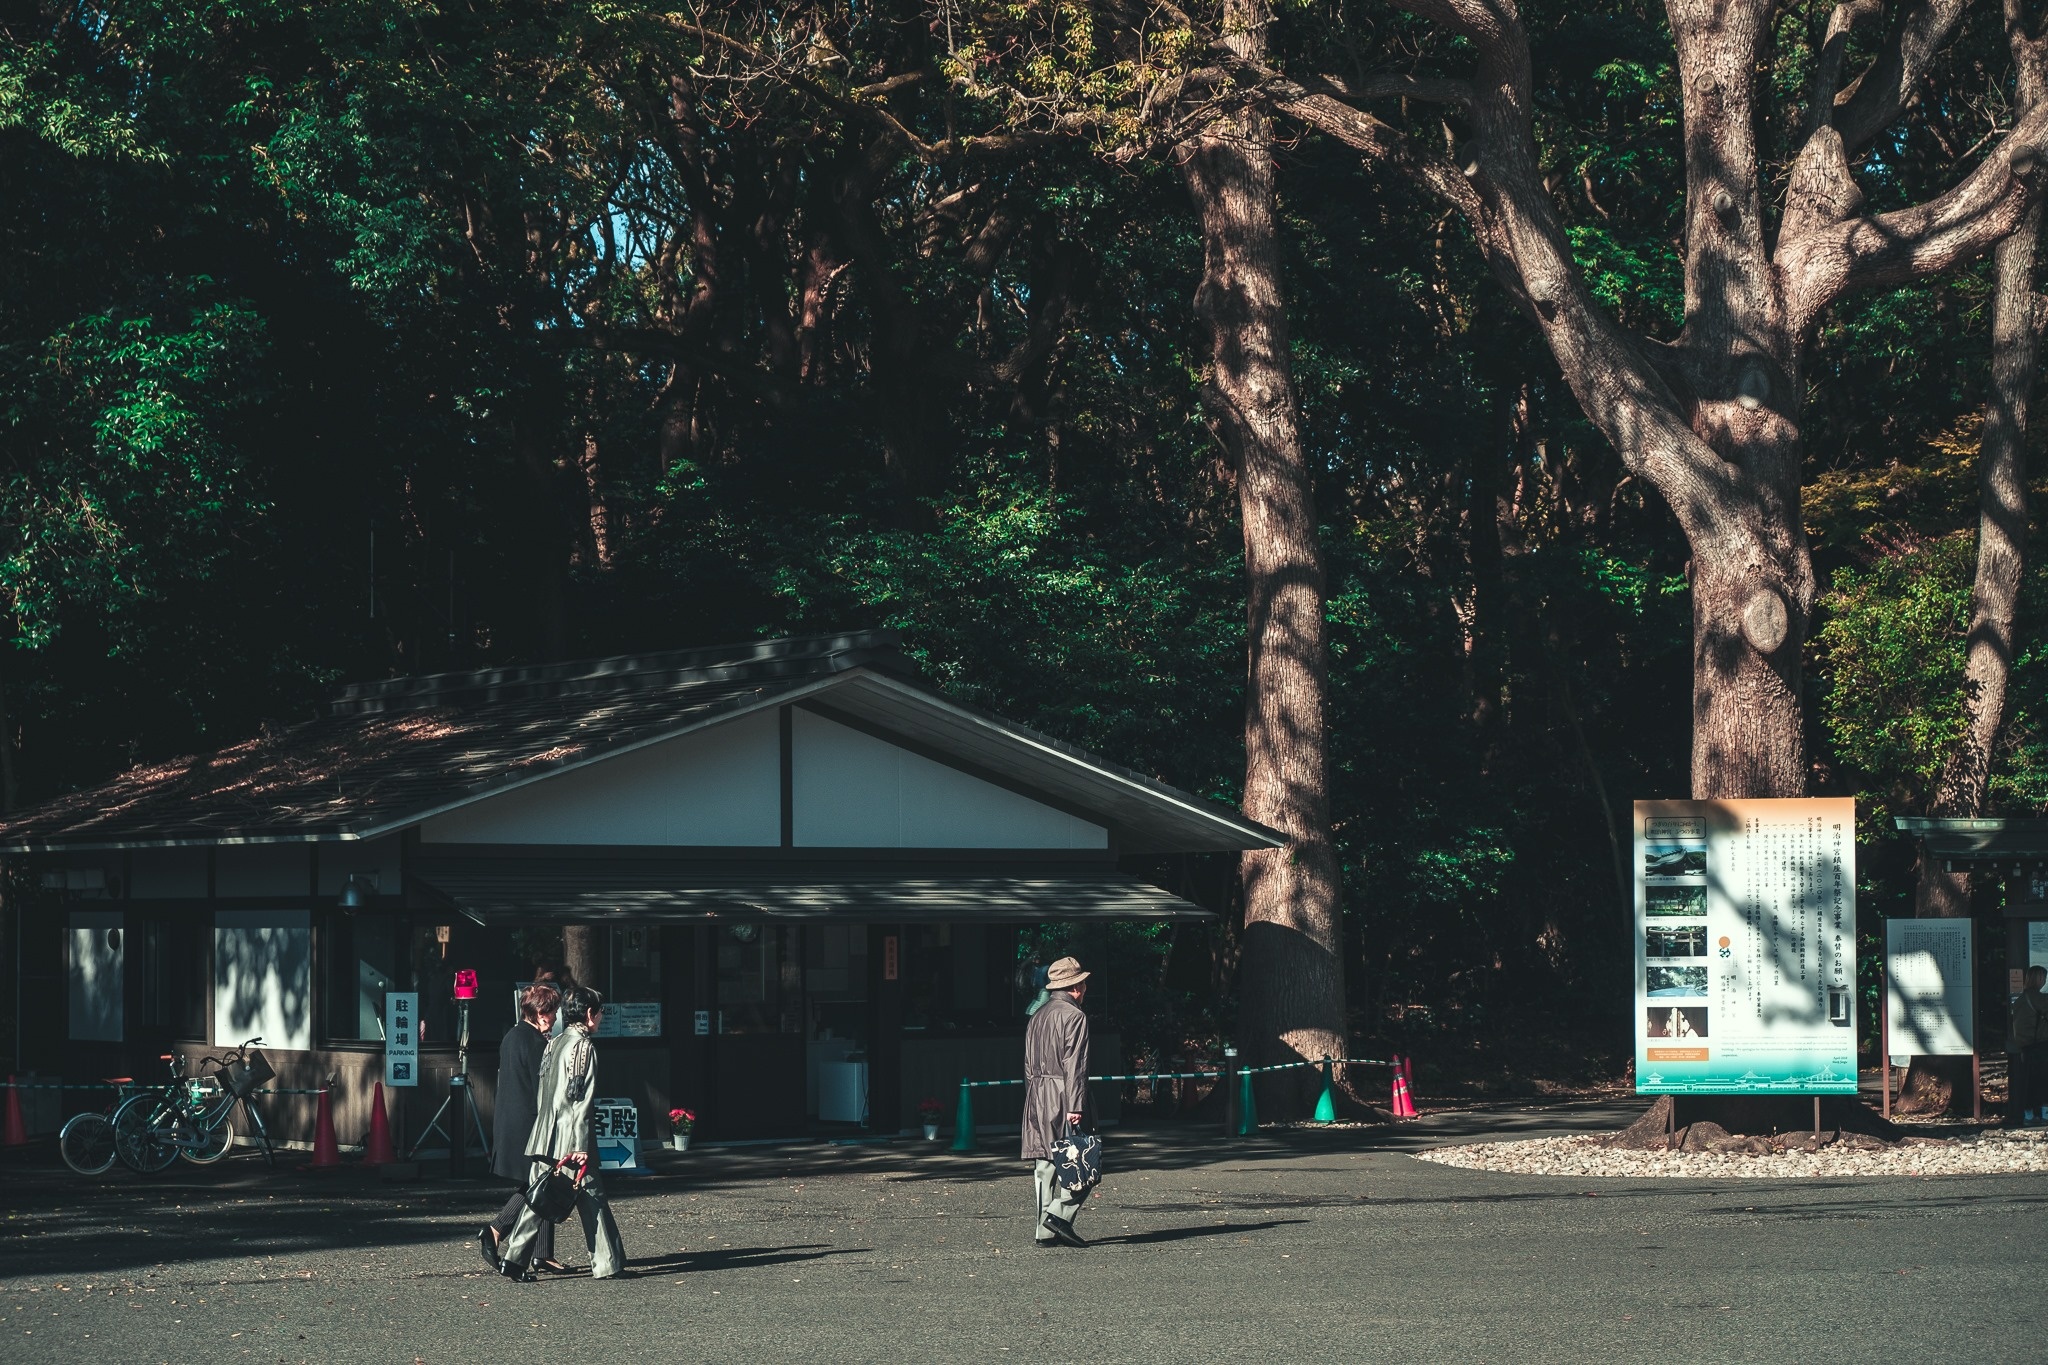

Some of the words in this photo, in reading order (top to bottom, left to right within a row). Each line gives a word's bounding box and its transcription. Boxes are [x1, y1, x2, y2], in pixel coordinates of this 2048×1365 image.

[1832, 823, 1842, 929] 明治神宮鎮座百年祭記念事業
[1833, 934, 1843, 983] 奉賛のお願い
[395, 999, 409, 1046] 駐輪場
